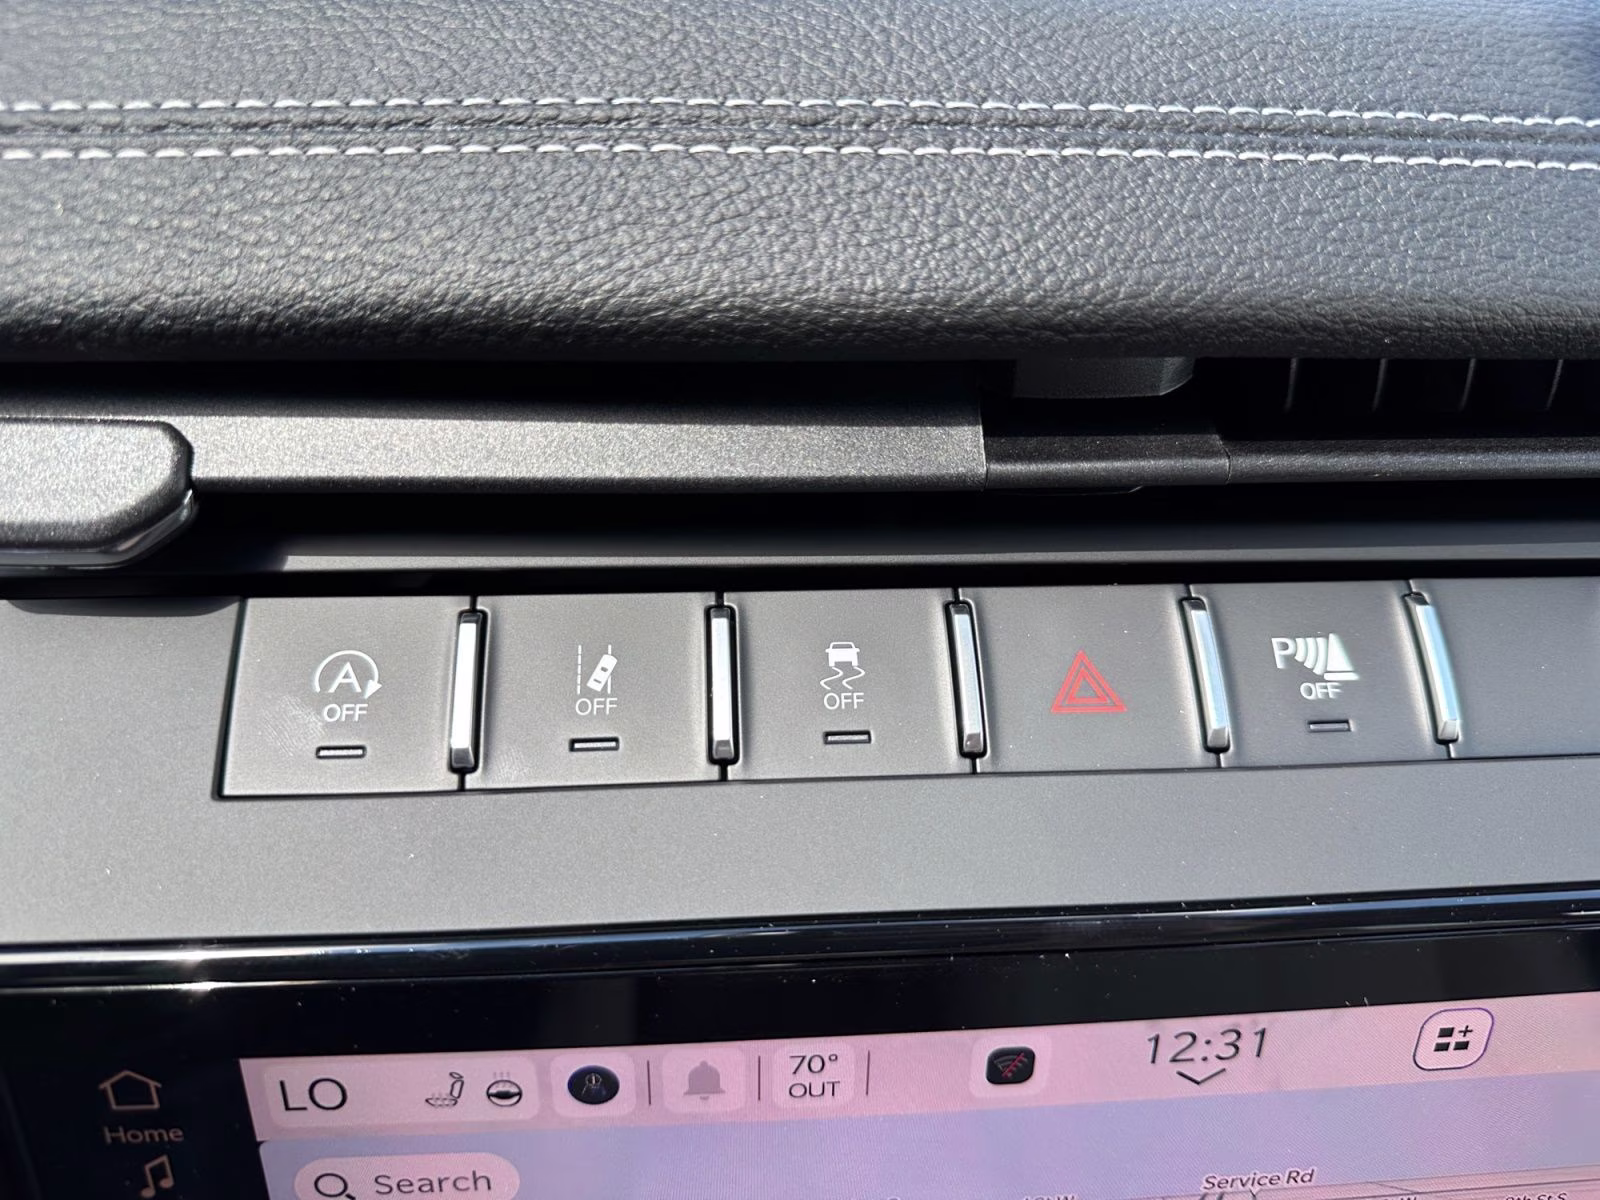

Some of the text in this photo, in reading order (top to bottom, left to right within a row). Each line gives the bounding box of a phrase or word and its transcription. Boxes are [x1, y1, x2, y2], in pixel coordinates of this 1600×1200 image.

[327, 661, 362, 693] A
[823, 692, 865, 710] OFF
[1300, 682, 1342, 701] OFF
[323, 703, 369, 722] OFF
[575, 697, 618, 716] OFF
[1146, 1027, 1267, 1064] 12:31
[788, 1053, 839, 1075] 70°
[279, 1077, 349, 1112] LO
[788, 1080, 841, 1099] OUT
[102, 1125, 185, 1145] Home
[373, 1169, 493, 1196] Search
[1202, 1168, 1315, 1190] Service Rd
